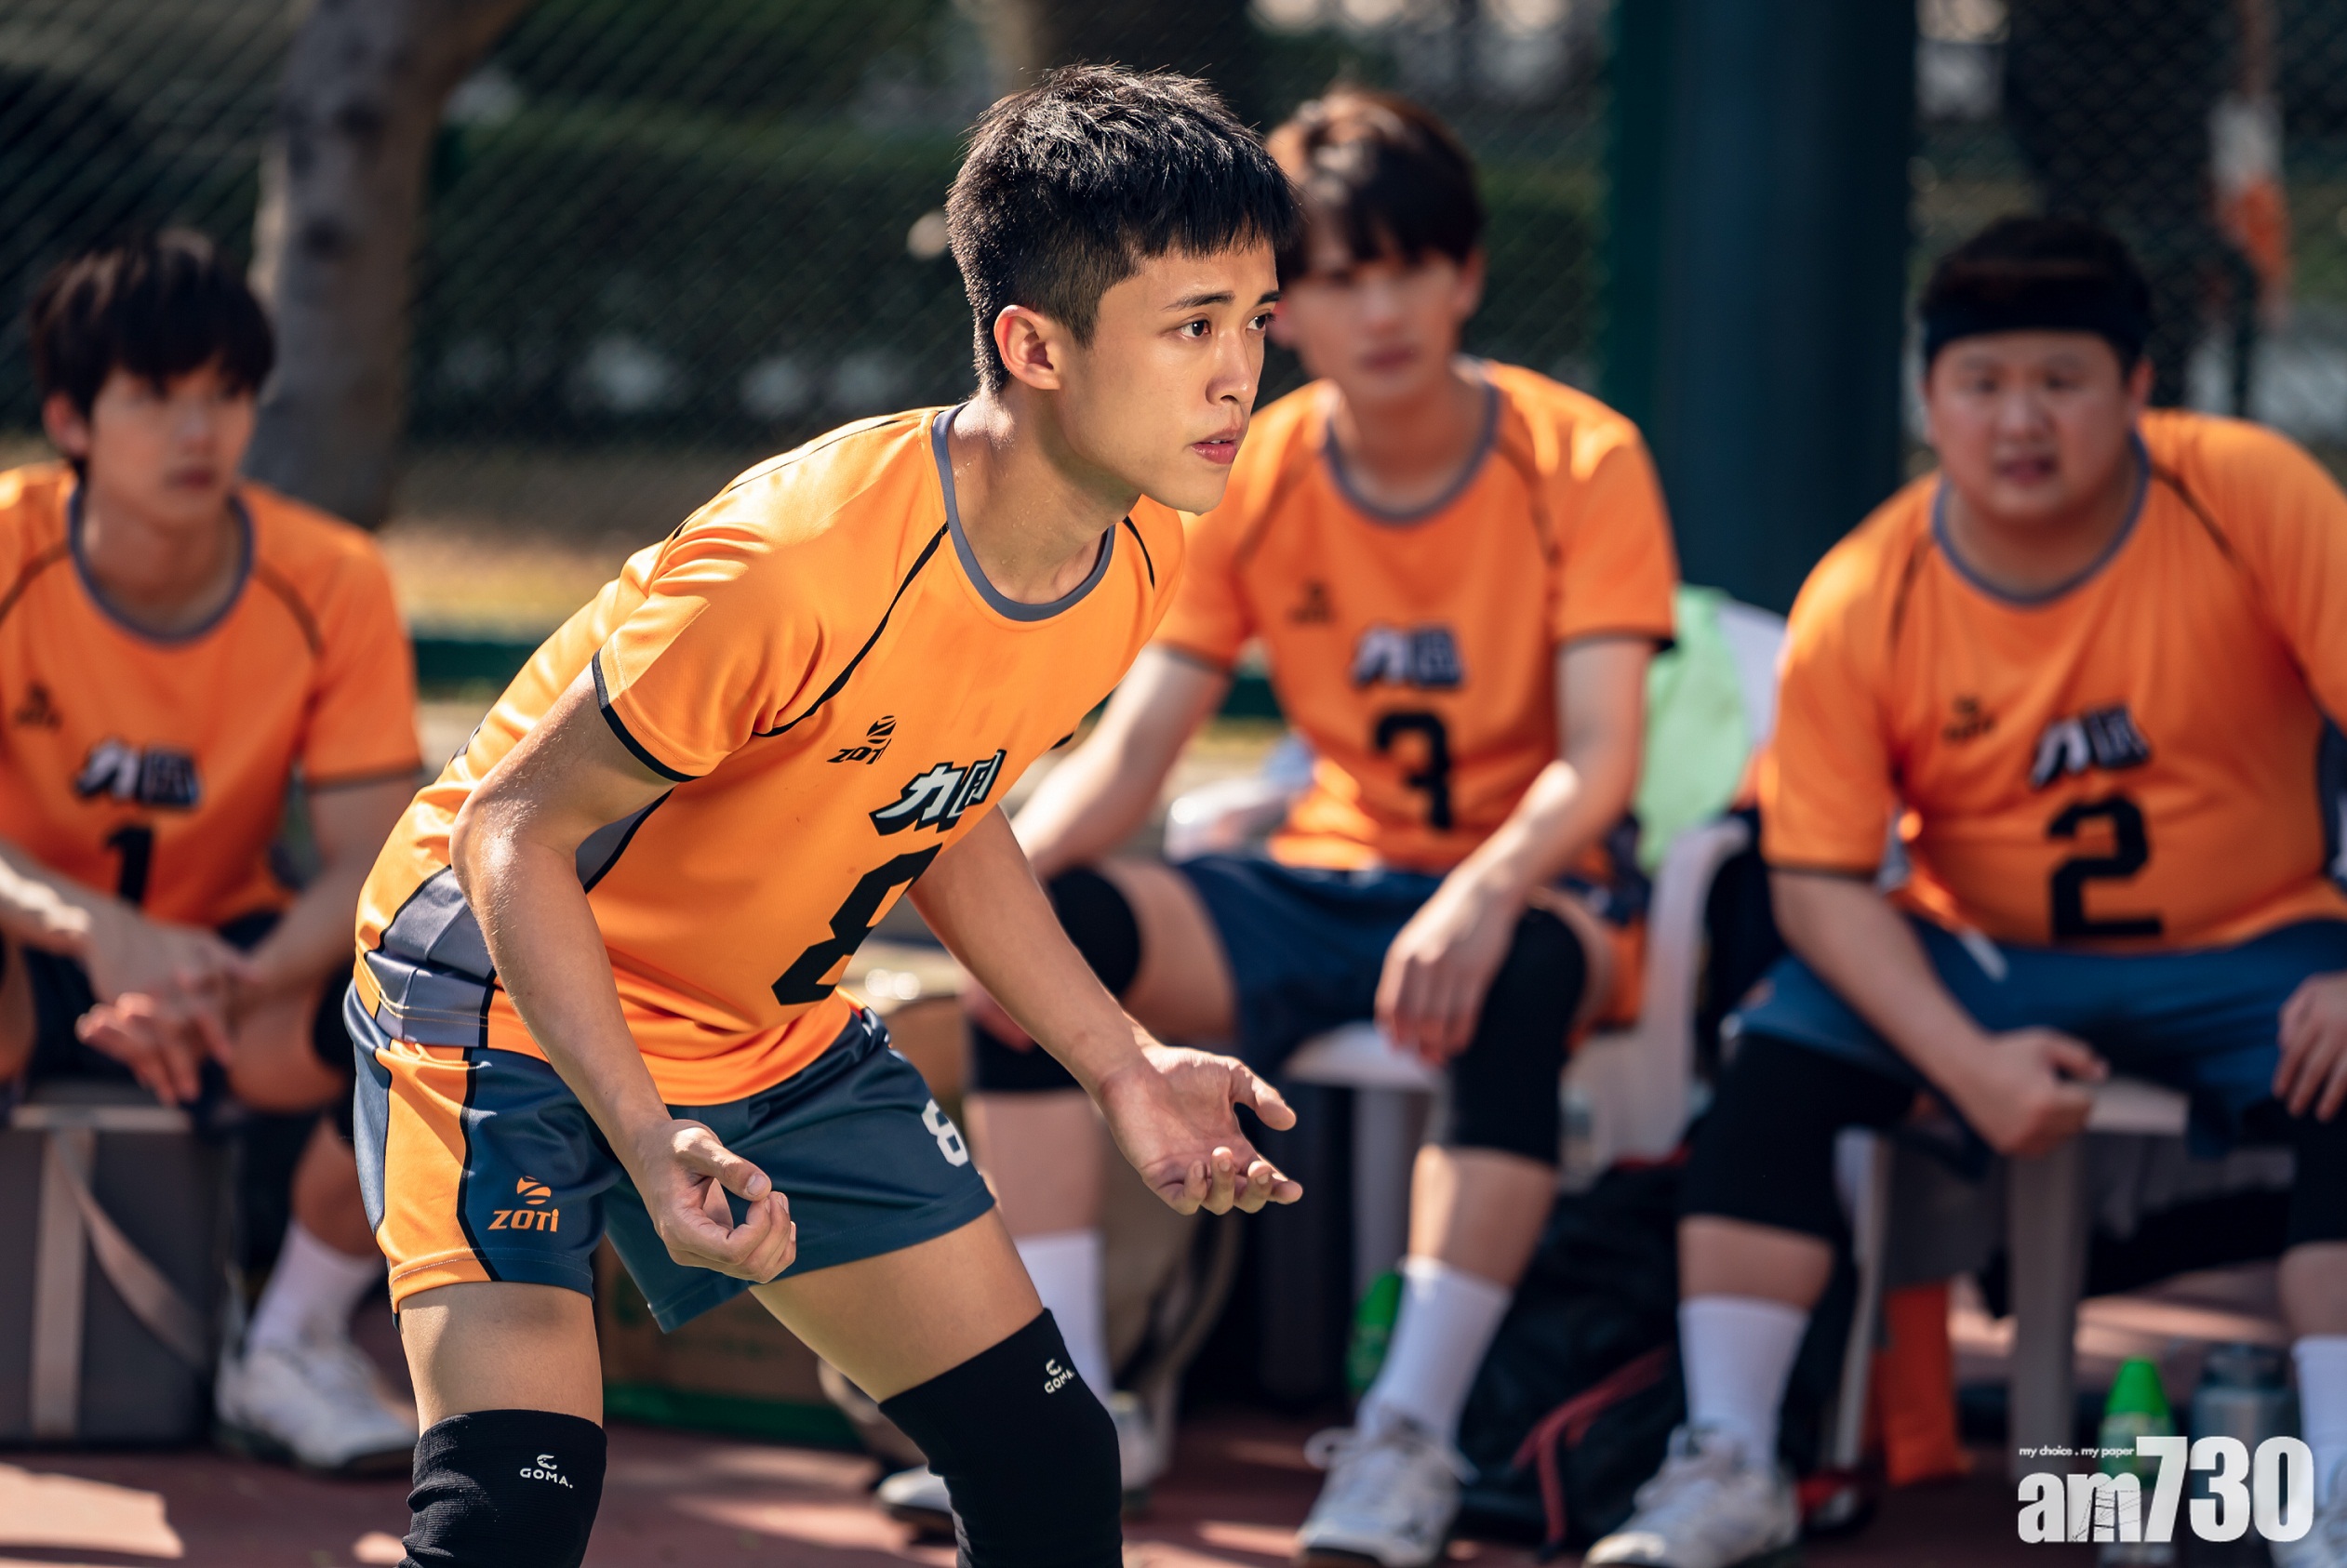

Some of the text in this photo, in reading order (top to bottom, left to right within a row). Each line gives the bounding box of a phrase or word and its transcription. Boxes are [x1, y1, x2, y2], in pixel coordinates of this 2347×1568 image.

[1375, 711, 1451, 831] 3
[104, 822, 155, 906] 1
[2047, 794, 2162, 939] 2
[921, 1098, 969, 1167] 8
